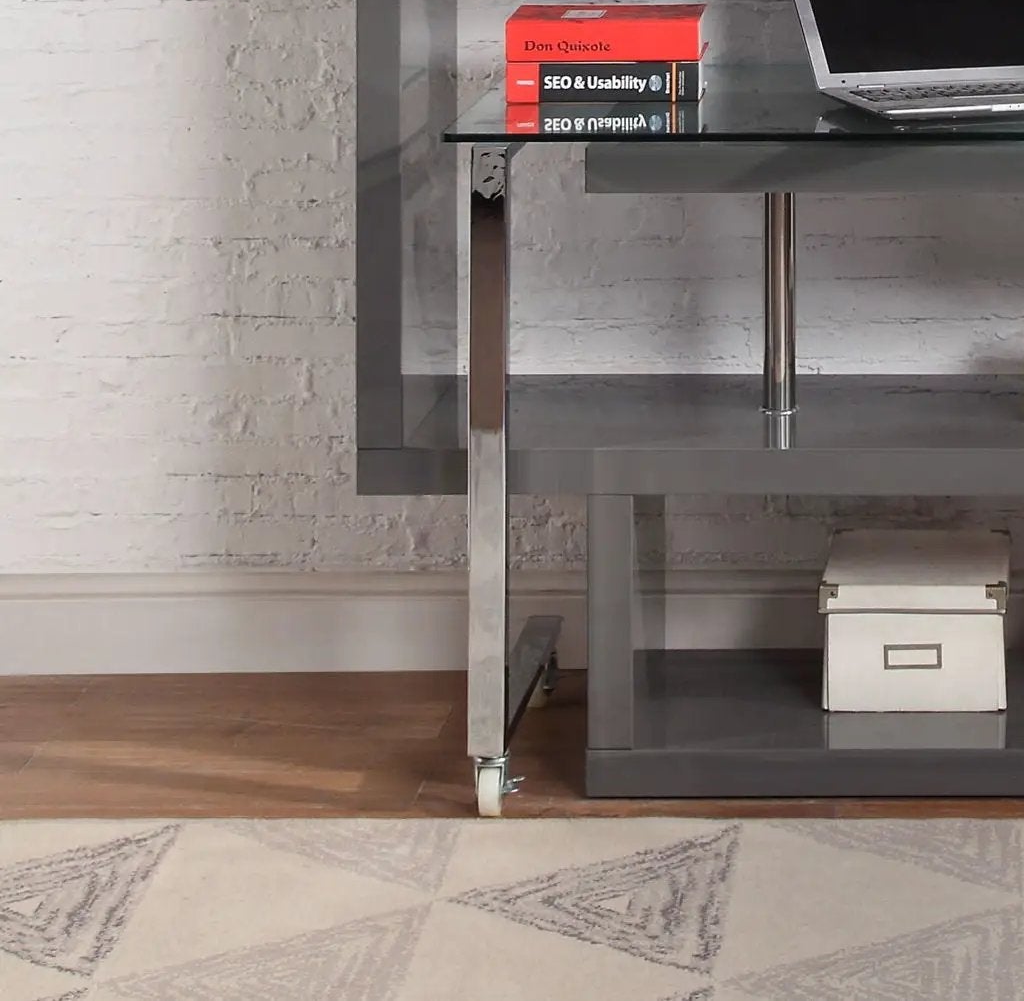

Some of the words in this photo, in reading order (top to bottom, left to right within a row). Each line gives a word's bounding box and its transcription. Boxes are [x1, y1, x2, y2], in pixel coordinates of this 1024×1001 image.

[524, 41, 553, 52] Don
[557, 41, 611, 53] Quixote
[543, 75, 572, 90] SEO
[573, 75, 586, 90] &
[587, 75, 647, 93] Usability
